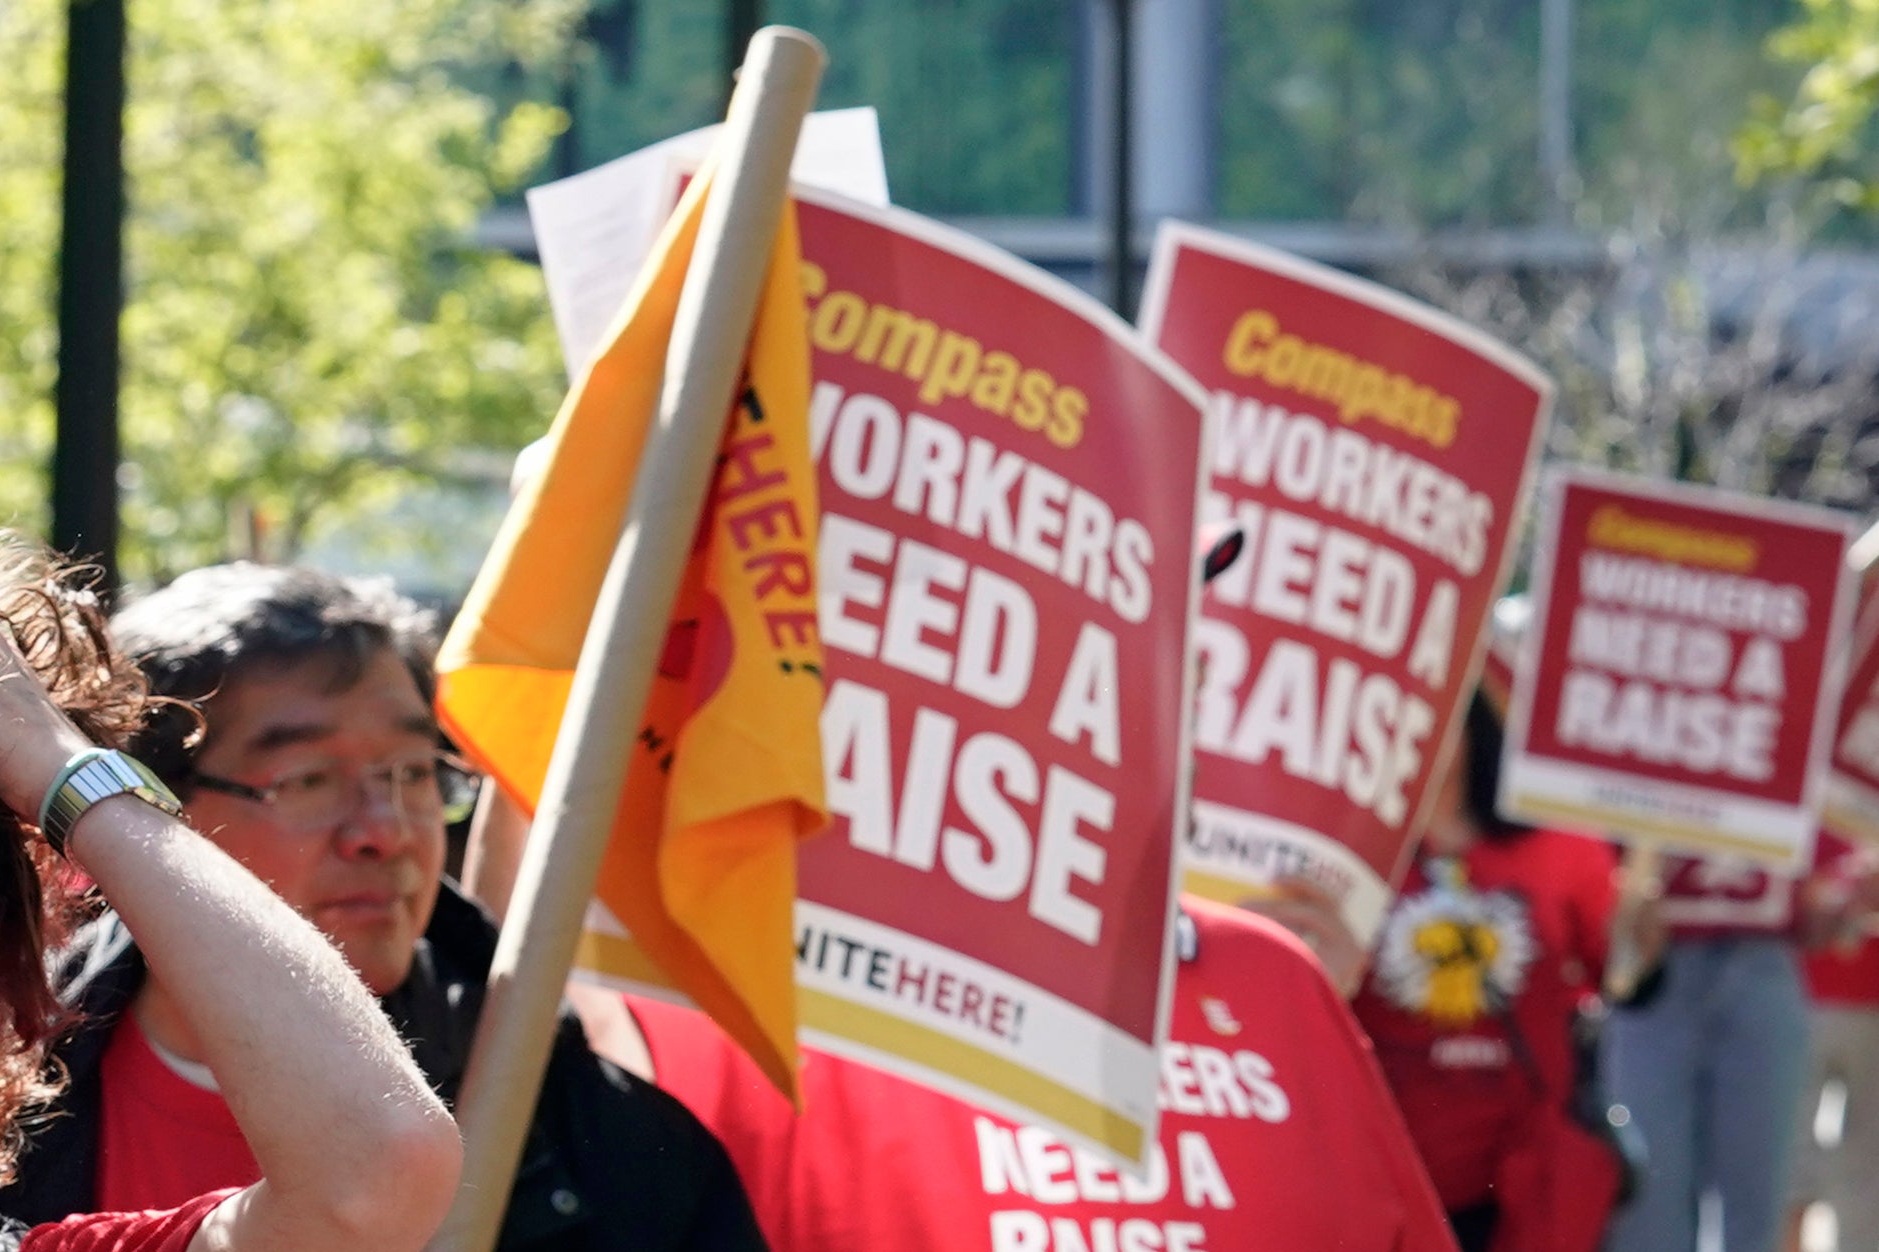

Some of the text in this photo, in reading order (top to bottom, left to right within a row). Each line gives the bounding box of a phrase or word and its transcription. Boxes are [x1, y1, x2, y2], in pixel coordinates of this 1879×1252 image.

[1223, 309, 1462, 449] Compass
[1209, 390, 1495, 579] WORKERS
[818, 510, 1119, 767] EED A
[1408, 579, 1461, 688] A
[1564, 605, 1786, 700] NEED A
[1194, 624, 1435, 830] RAISE
[1555, 670, 1785, 784] RAISE
[819, 676, 1116, 948] AISE
[794, 925, 1025, 1045] NITEHERE!
[1177, 1131, 1237, 1210] A
